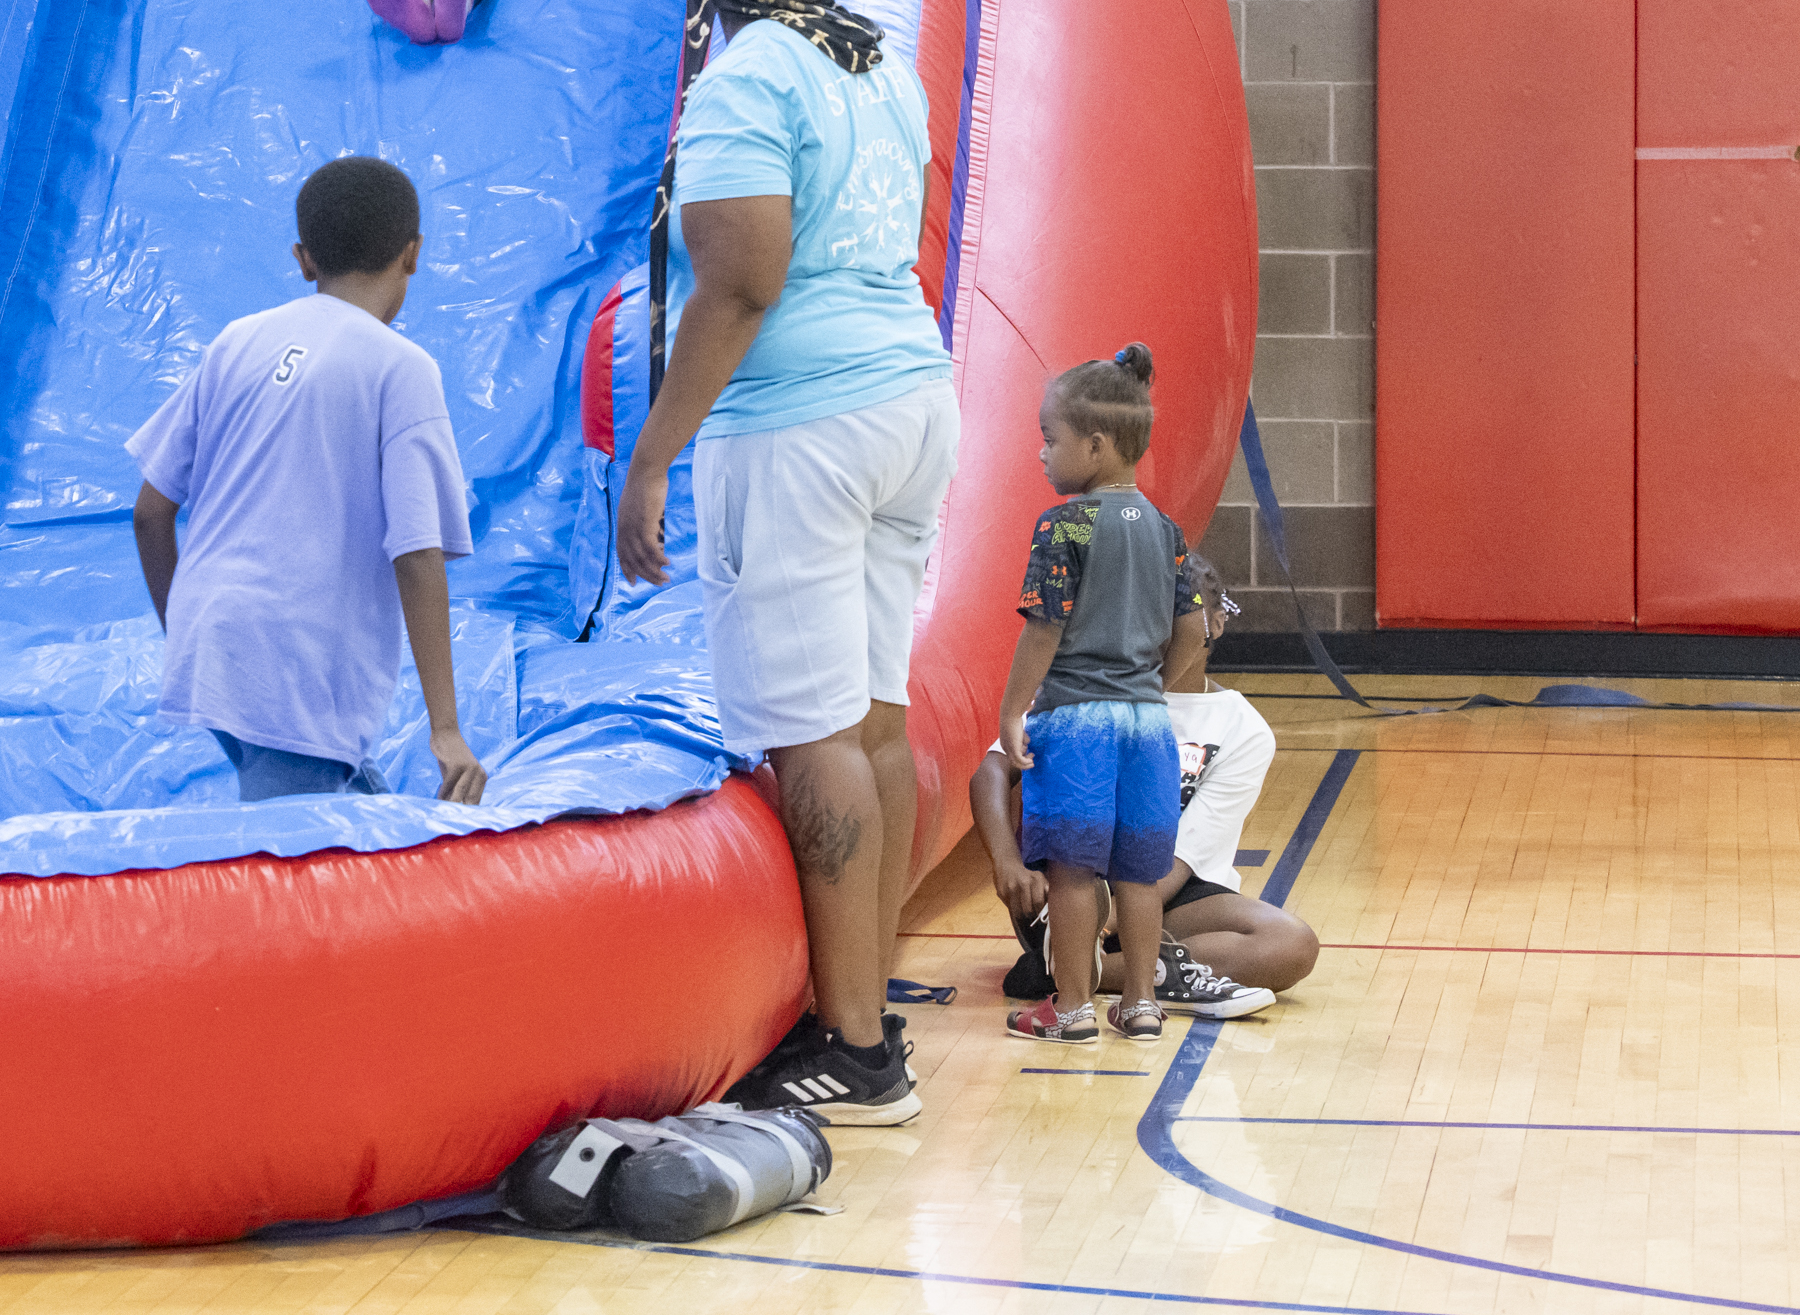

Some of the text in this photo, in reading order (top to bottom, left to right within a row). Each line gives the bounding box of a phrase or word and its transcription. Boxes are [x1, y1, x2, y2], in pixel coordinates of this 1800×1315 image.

[272, 344, 309, 386] 5
[1054, 520, 1093, 535] UNDER
[1051, 531, 1092, 546] ARMOU
